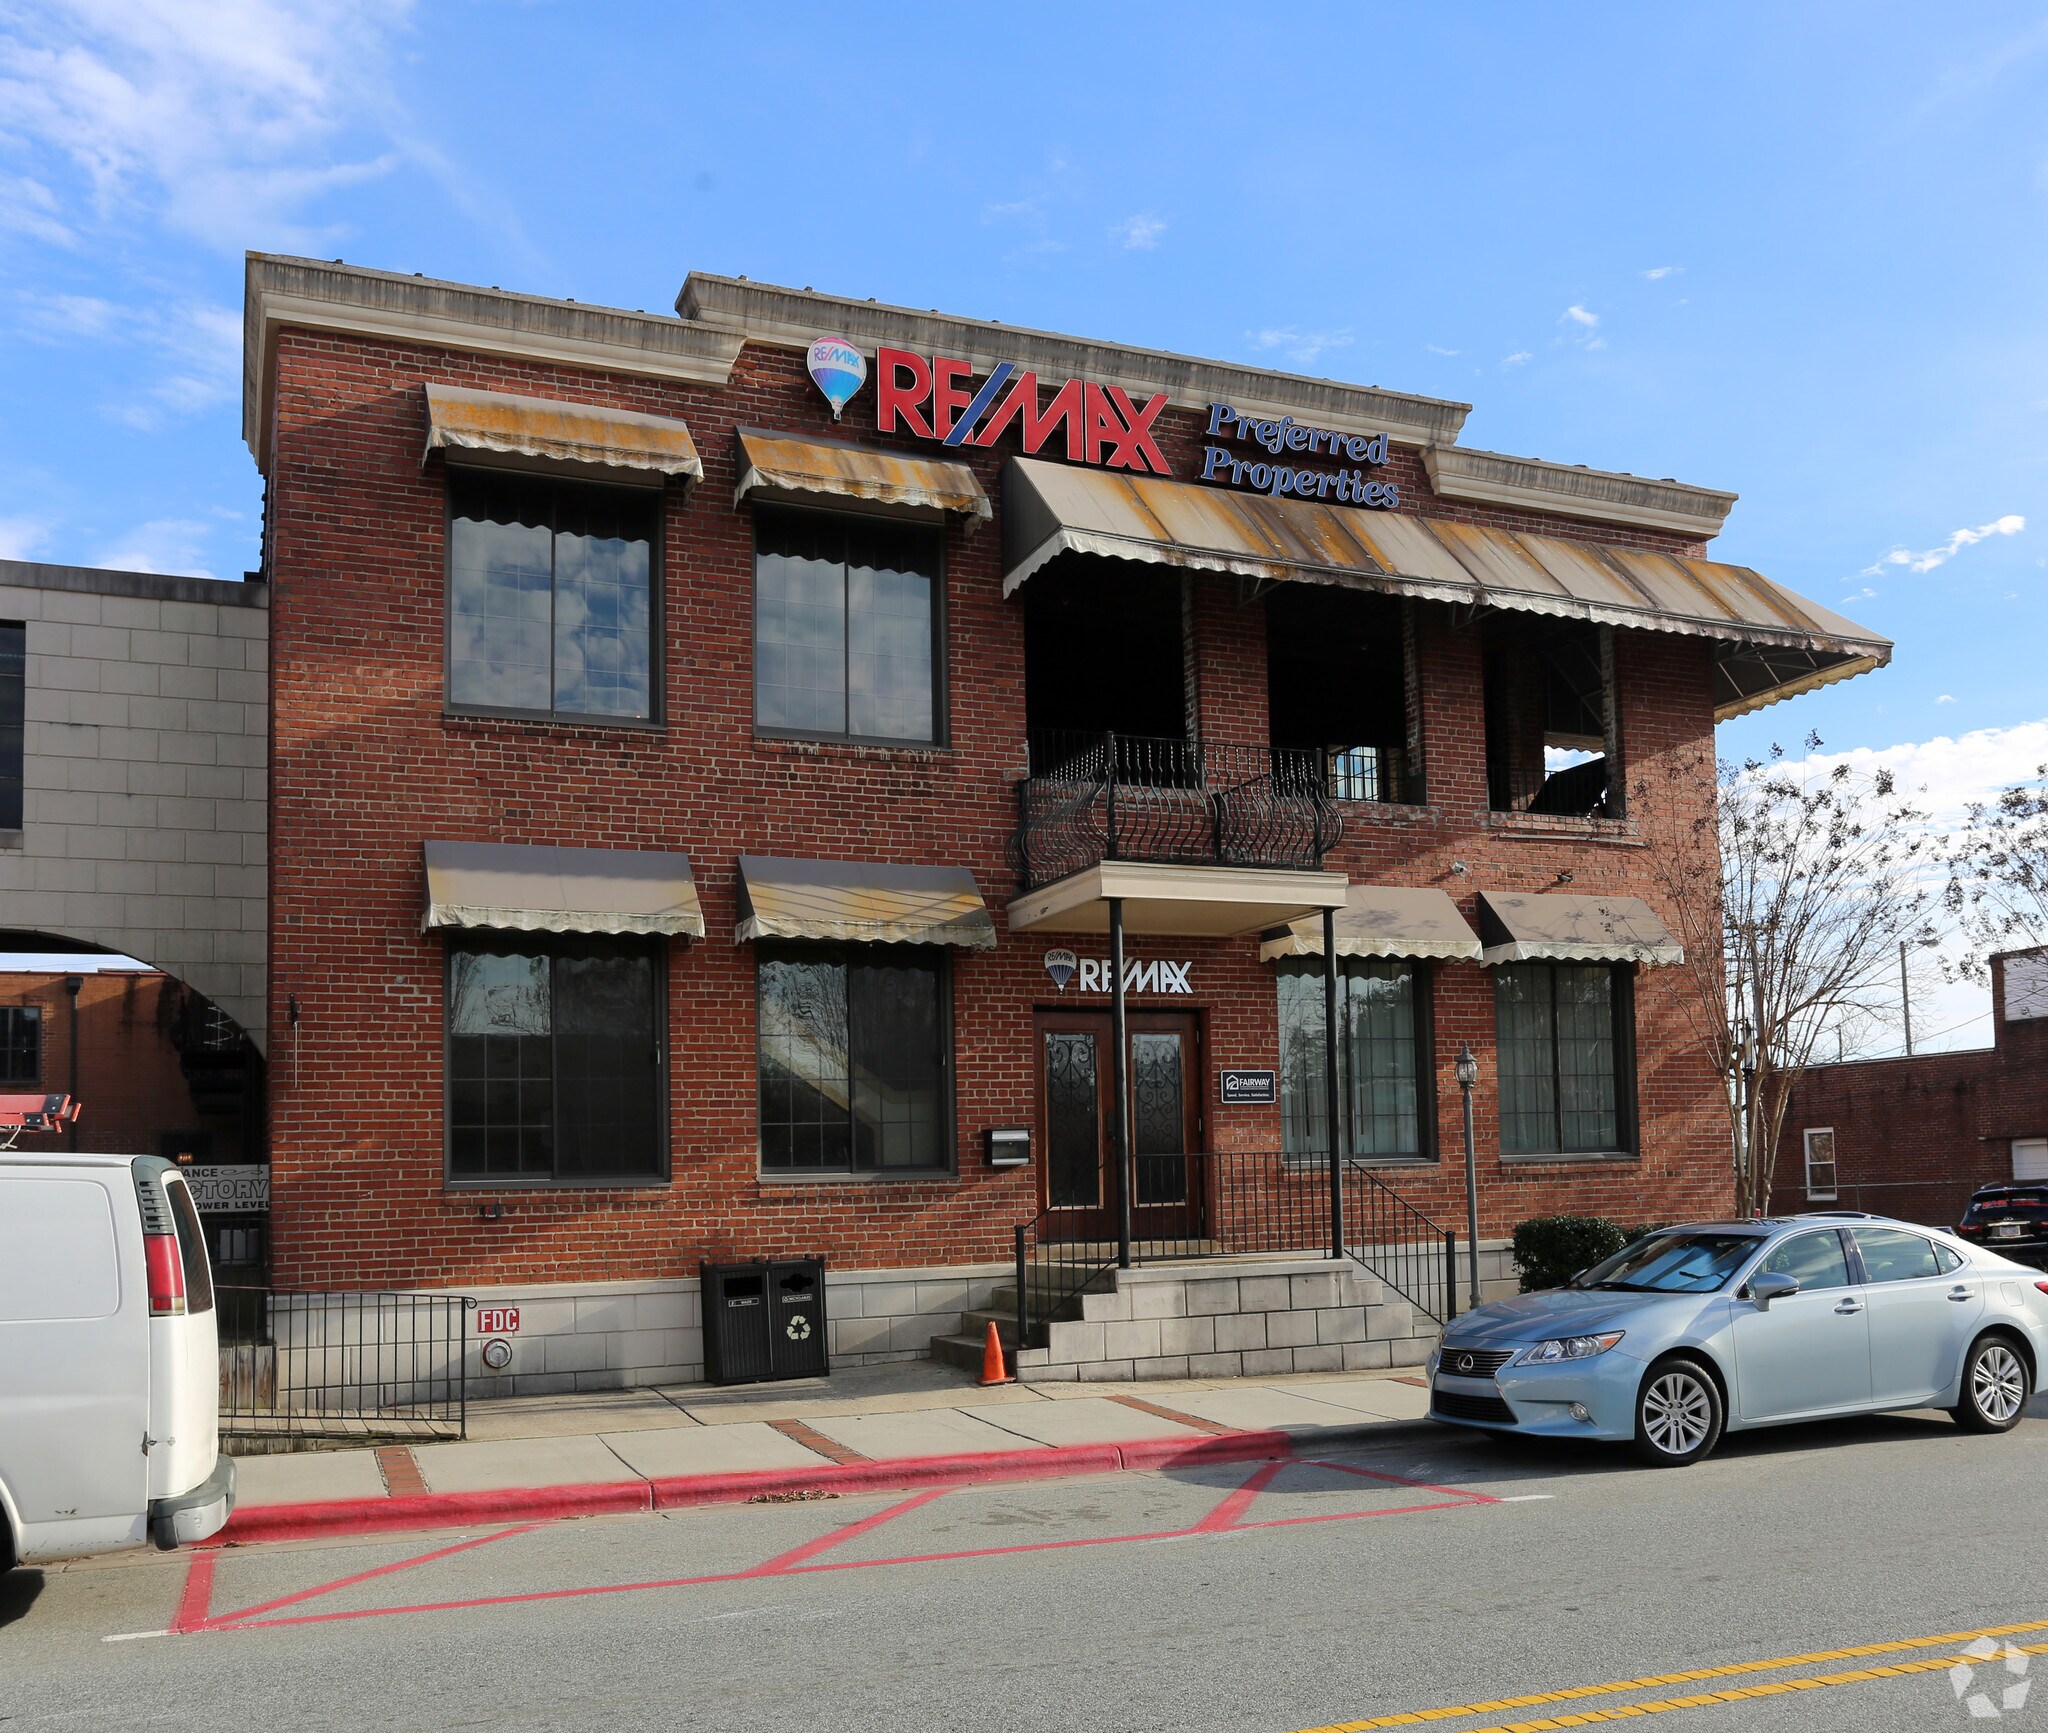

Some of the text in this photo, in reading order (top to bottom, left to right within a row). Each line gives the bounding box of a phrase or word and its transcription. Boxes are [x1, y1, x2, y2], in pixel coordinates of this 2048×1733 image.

[814, 346, 859, 369] RE/MAX
[877, 346, 1173, 476] RE/MAX
[1205, 402, 1391, 465] Preferred
[1200, 446, 1400, 509] Properties
[1047, 951, 1074, 962] RE/MAX
[1239, 1078, 1271, 1086] FAIRWAY
[183, 1168, 218, 1177] ANCE
[186, 1180, 268, 1200] CTORY
[196, 1202, 229, 1210] OWER
[480, 1309, 517, 1331] FDC
